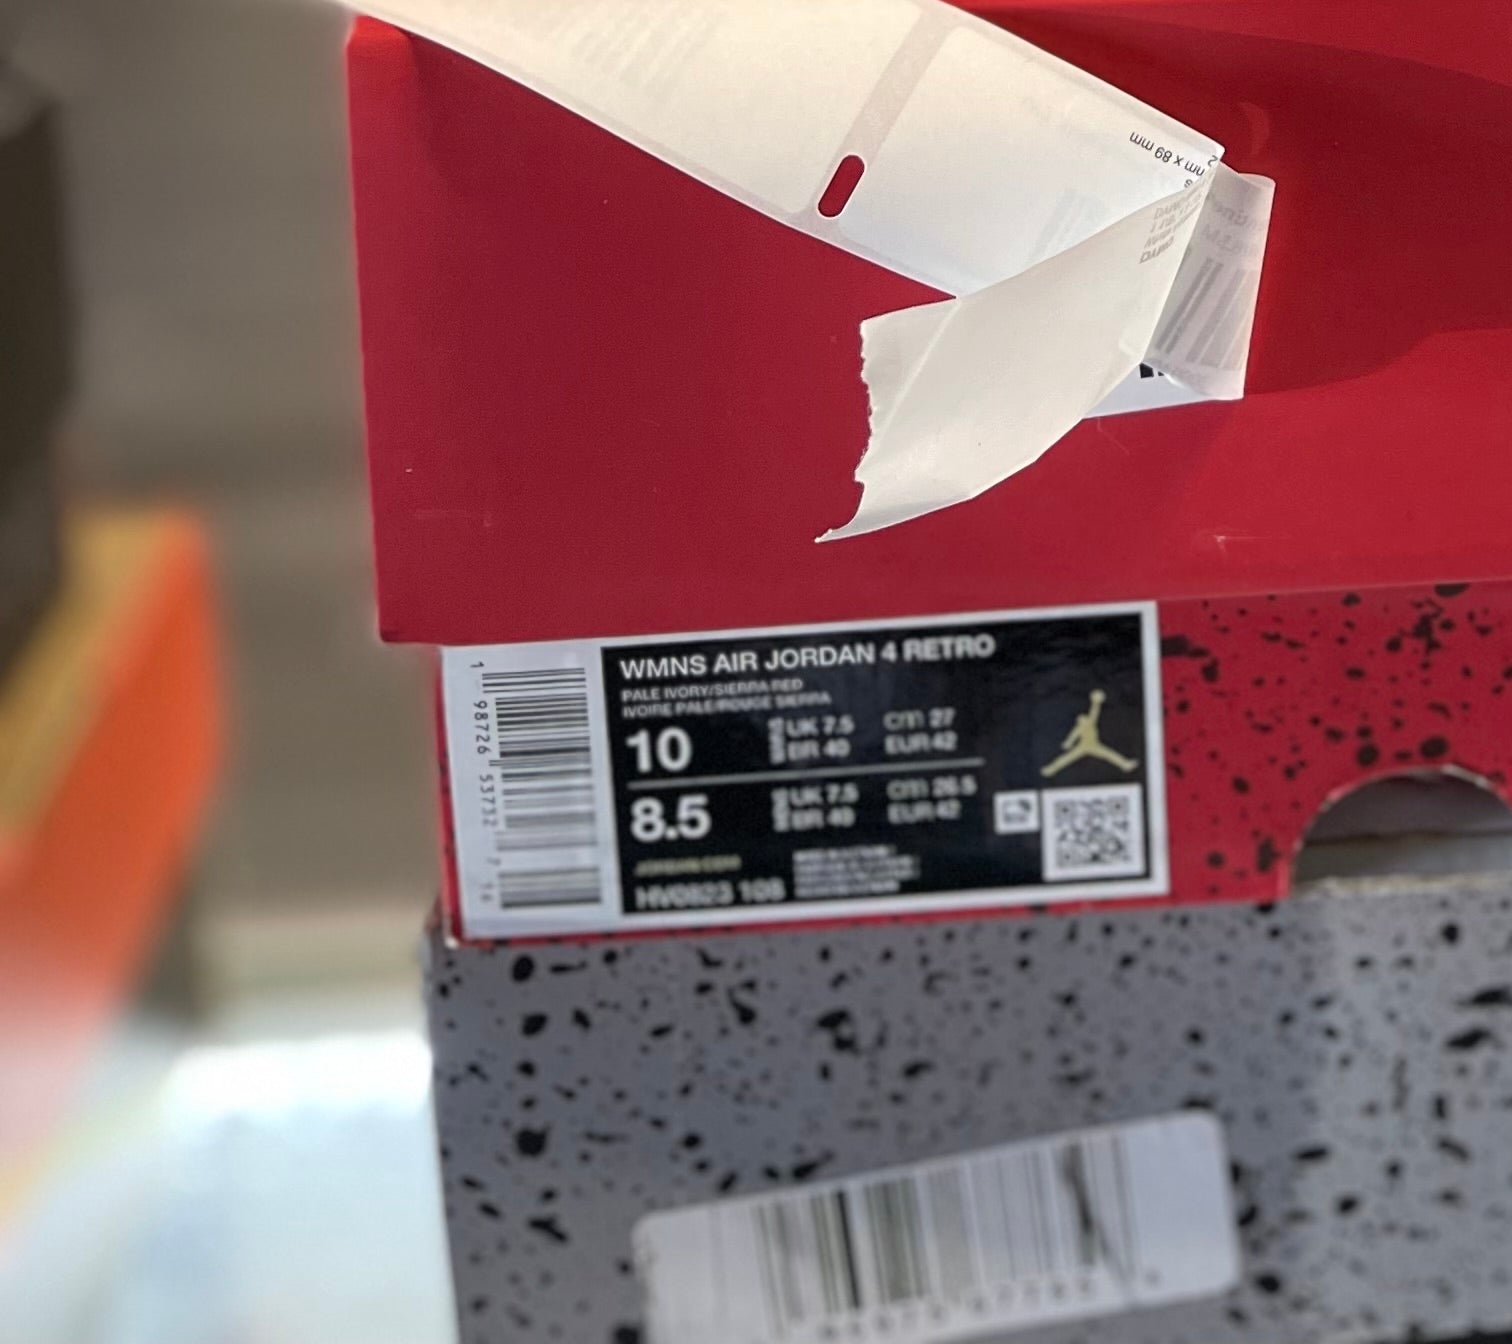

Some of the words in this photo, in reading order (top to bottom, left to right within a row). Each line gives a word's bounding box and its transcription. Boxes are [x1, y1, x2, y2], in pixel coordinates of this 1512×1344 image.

[1129, 131, 1155, 152] mm
[1154, 146, 1173, 163] 89
[1173, 155, 1184, 167] x
[620, 654, 708, 680] WMNS
[713, 651, 758, 675] AIR
[765, 642, 876, 671] JORDAN
[880, 640, 898, 662] 4
[902, 633, 996, 662] RETRO
[622, 687, 661, 703] PALE
[771, 678, 803, 693] RED
[473, 700, 491, 756] 98726
[786, 716, 819, 738] UK
[822, 714, 855, 736] 7.5
[928, 707, 956, 728] 27
[625, 725, 693, 773] 10
[885, 732, 931, 755] EUR
[932, 730, 958, 752] 42
[789, 785, 823, 807] UK
[826, 782, 859, 804] 7.5
[630, 794, 711, 842] 8.5
